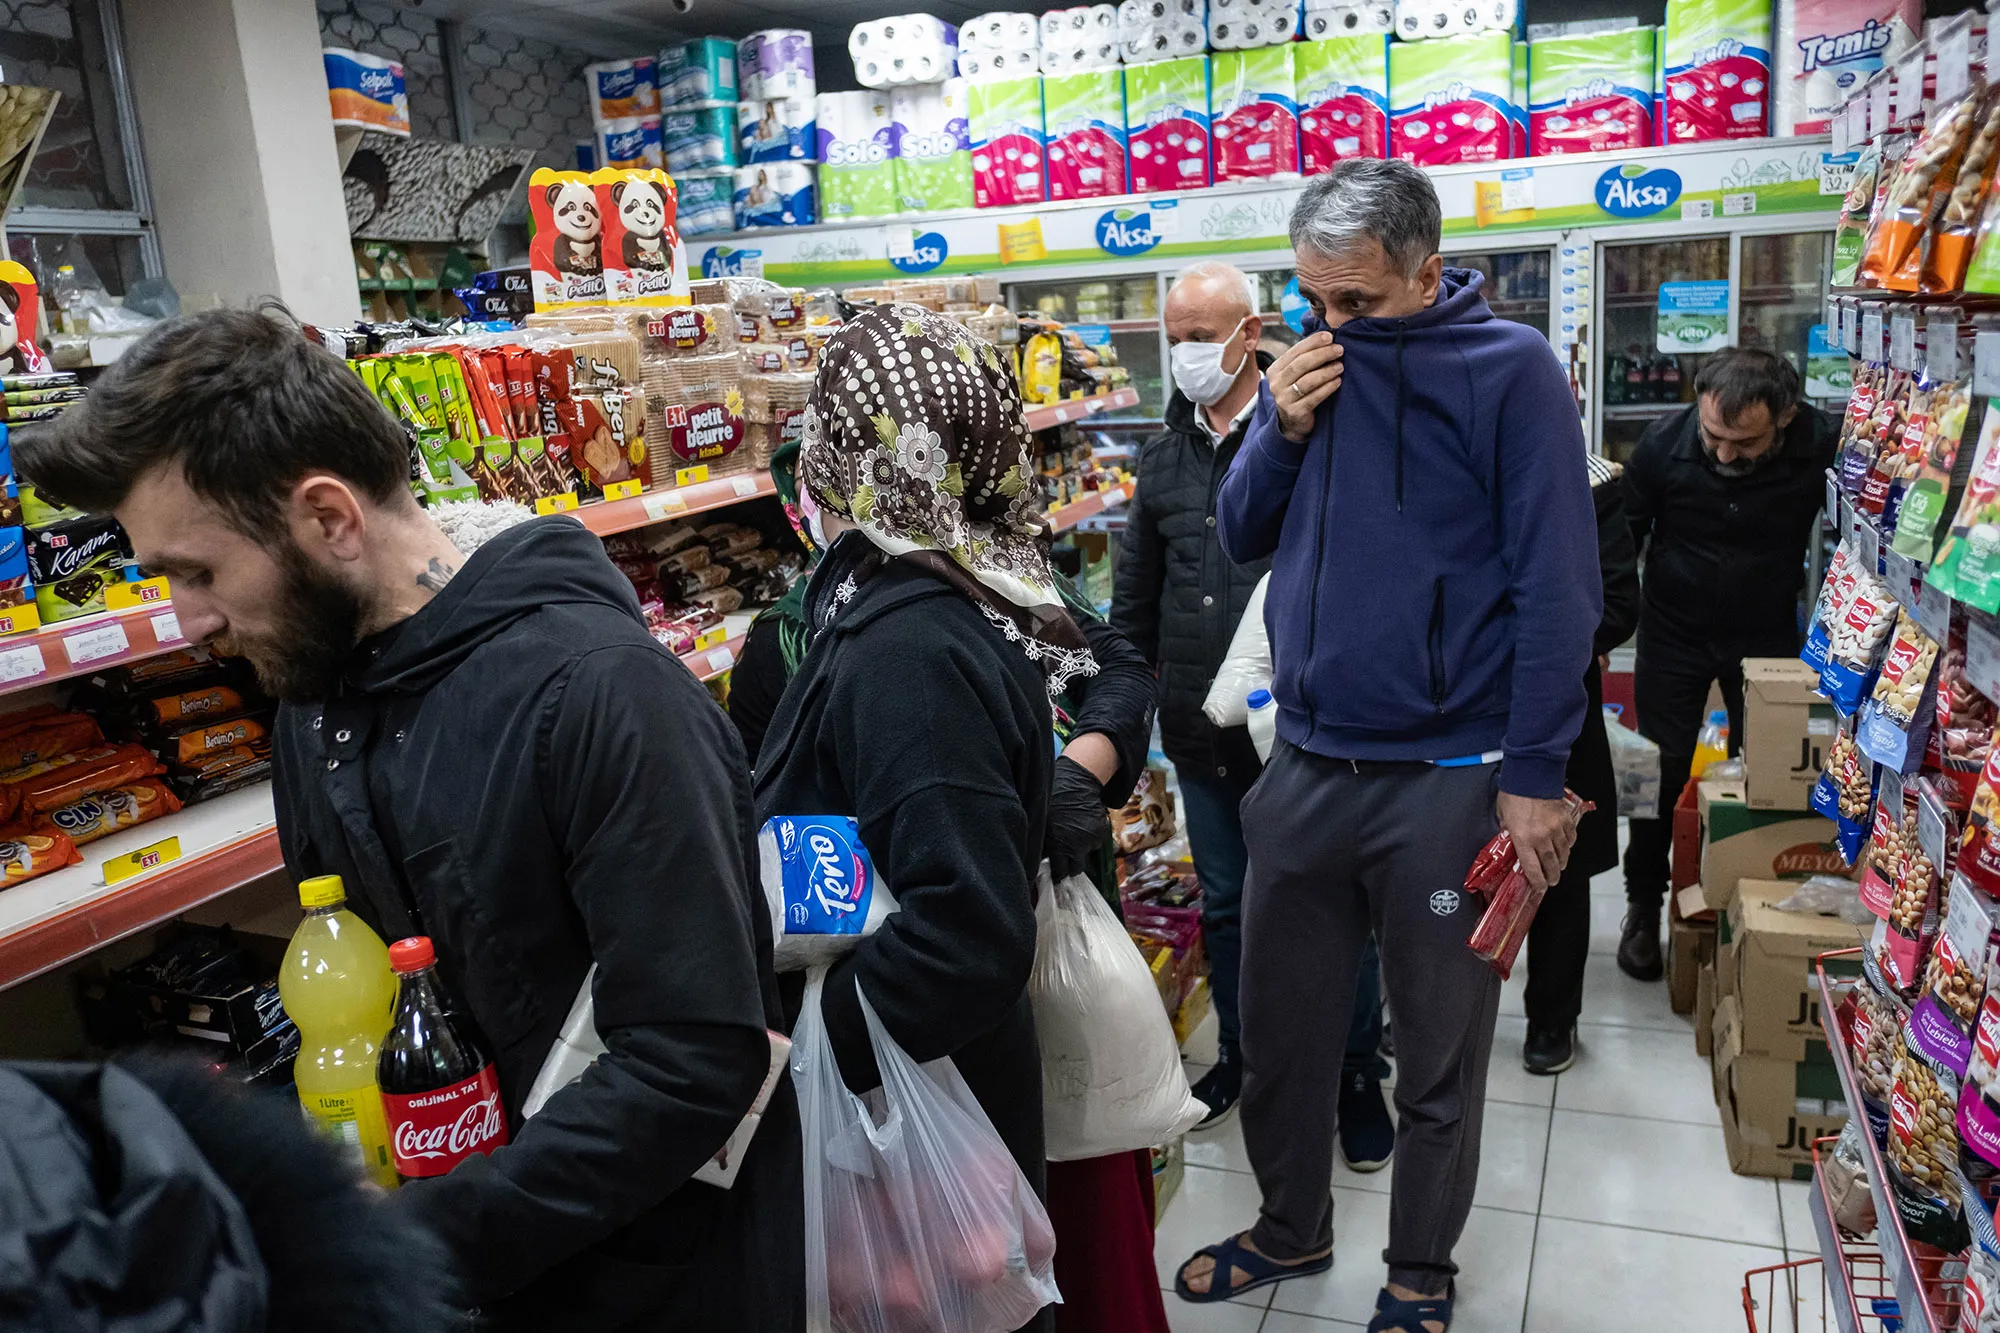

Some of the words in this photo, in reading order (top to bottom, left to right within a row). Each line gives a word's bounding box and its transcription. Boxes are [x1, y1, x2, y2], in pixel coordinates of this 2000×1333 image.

[1798, 19, 1892, 73] Temis
[826, 139, 887, 167] Solo
[899, 132, 957, 160] Solo
[1604, 179, 1667, 209] Aksa
[1104, 221, 1154, 248] Aksa
[709, 258, 742, 277] Aks
[649, 321, 665, 336] ETi
[668, 326, 699, 339] beurre
[671, 314, 696, 327] petit
[666, 405, 687, 427] ETi
[691, 407, 724, 431] petit
[686, 425, 734, 449] beurre
[51, 535, 68, 548] ETi
[51, 531, 116, 575] Karam
[141, 586, 161, 601] ETi
[0, 618, 13, 631] Ti
[1791, 737, 1824, 772] Ju
[141, 852, 160, 869] ETi
[1778, 852, 1851, 870] MEYÖ
[809, 834, 856, 916] Teno
[1788, 992, 1823, 1026] Ju
[1926, 1023, 1960, 1049] Leblebi
[461, 1081, 479, 1095] TAT
[395, 1090, 501, 1159] Coca-Cola
[1978, 1125, 2000, 1148] Lebl
